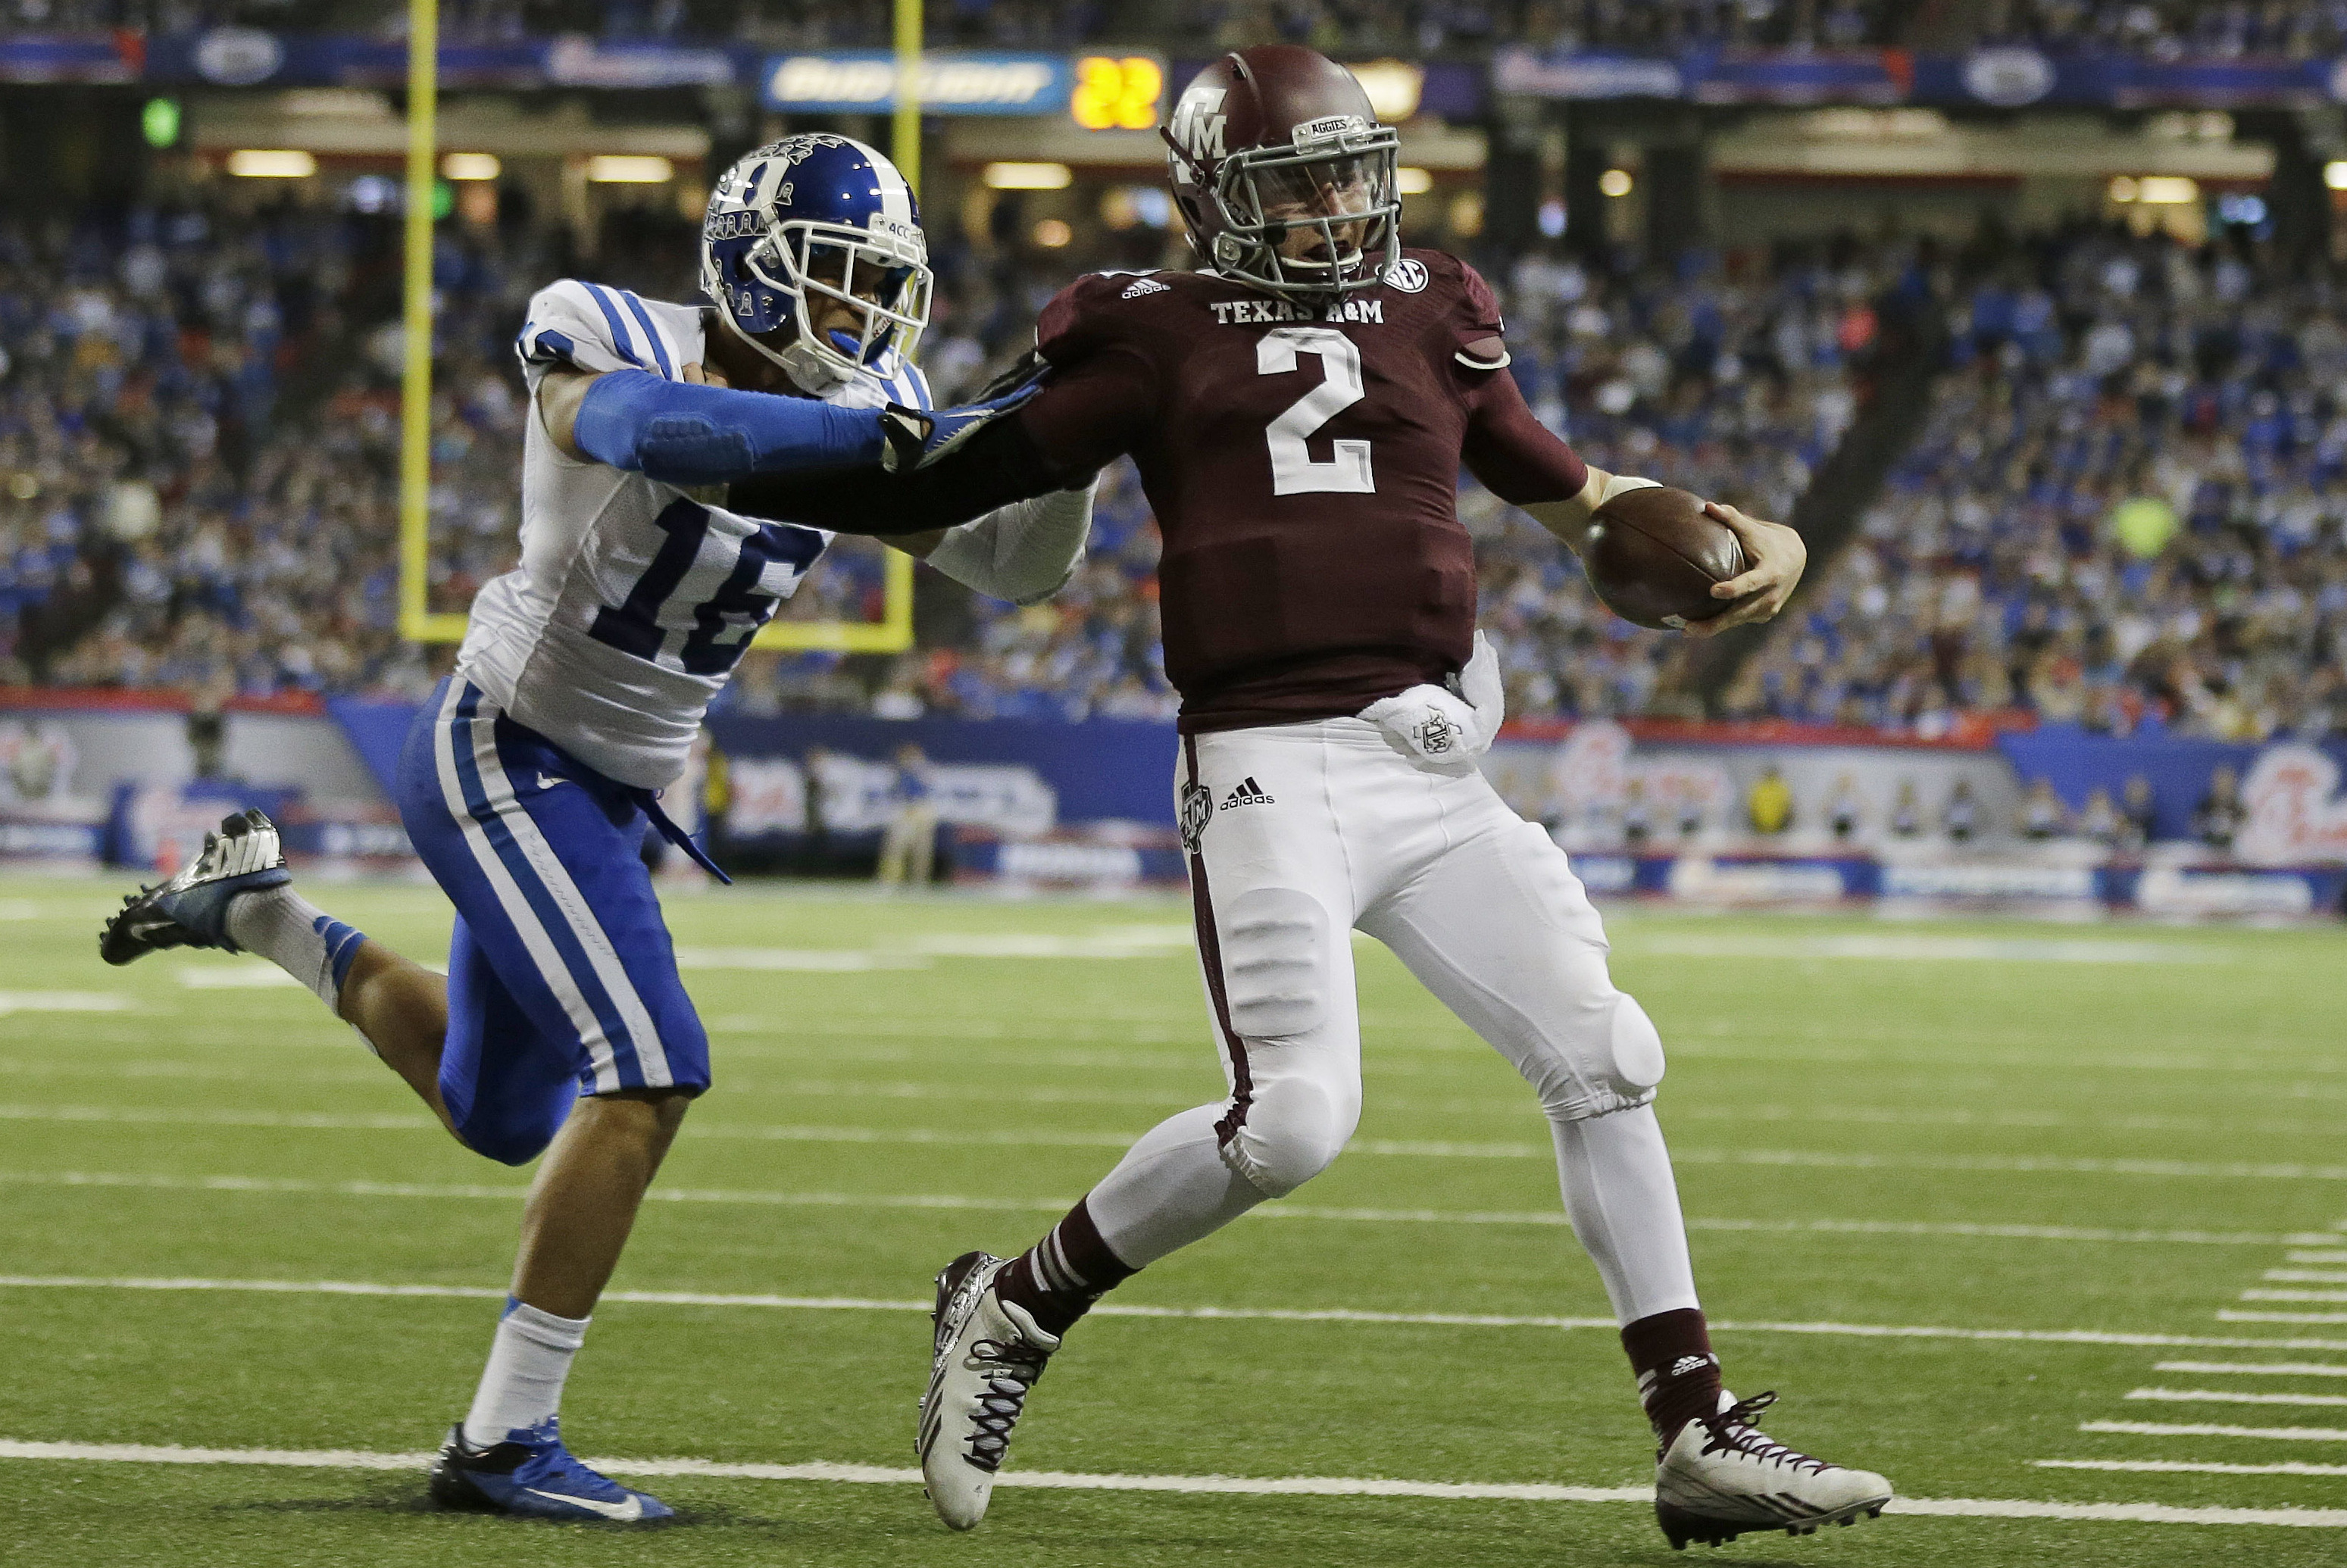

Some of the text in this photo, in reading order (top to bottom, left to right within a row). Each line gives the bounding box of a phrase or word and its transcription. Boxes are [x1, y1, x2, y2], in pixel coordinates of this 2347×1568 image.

[1311, 119, 1348, 134] AGGIES
[889, 223, 911, 239] ACC
[1121, 283, 1171, 299] adidas
[1210, 300, 1384, 324] TEXAS A&M
[1256, 327, 1376, 496] 2
[588, 496, 825, 675] 16
[1220, 794, 1275, 811] adidas
